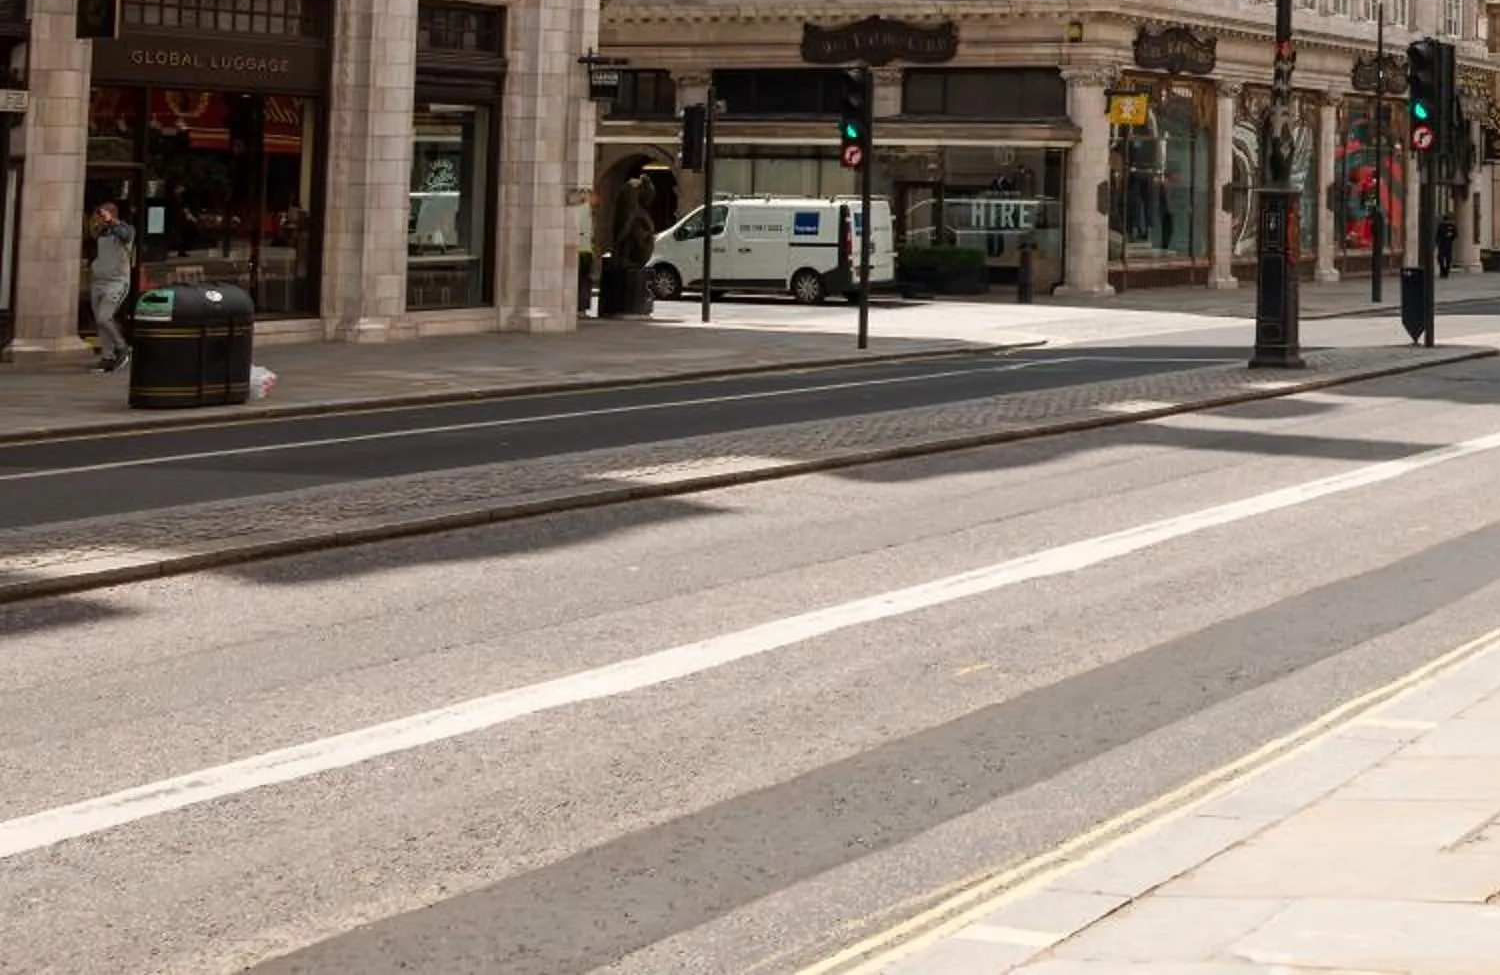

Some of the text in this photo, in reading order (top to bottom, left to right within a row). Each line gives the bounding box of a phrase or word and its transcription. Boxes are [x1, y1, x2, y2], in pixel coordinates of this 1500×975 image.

[131, 50, 289, 73] GLOBAL LUGGAGE
[971, 202, 1033, 228] HIRE
